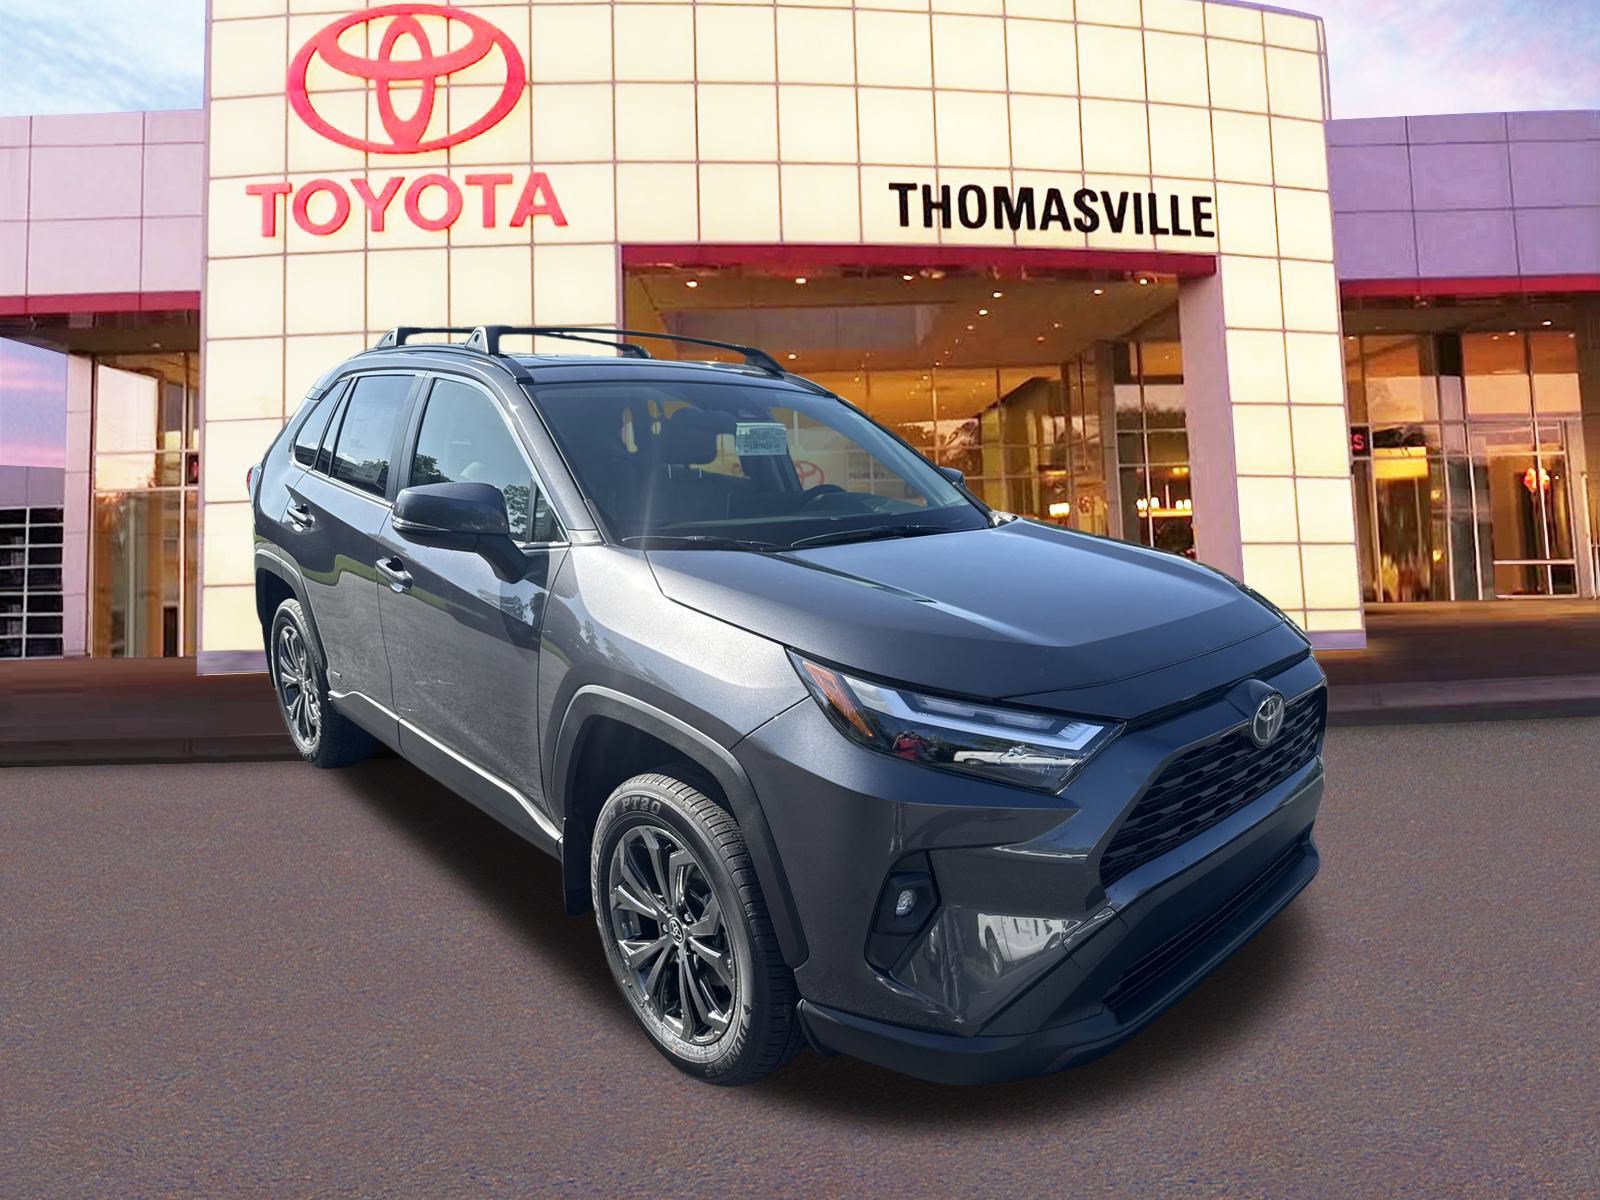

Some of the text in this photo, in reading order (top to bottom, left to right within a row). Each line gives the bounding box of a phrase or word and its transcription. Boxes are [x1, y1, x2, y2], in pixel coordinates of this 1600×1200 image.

[246, 172, 568, 237] TOYOTA
[889, 183, 1215, 237] THOMASVILLE
[622, 796, 661, 814] PT20
